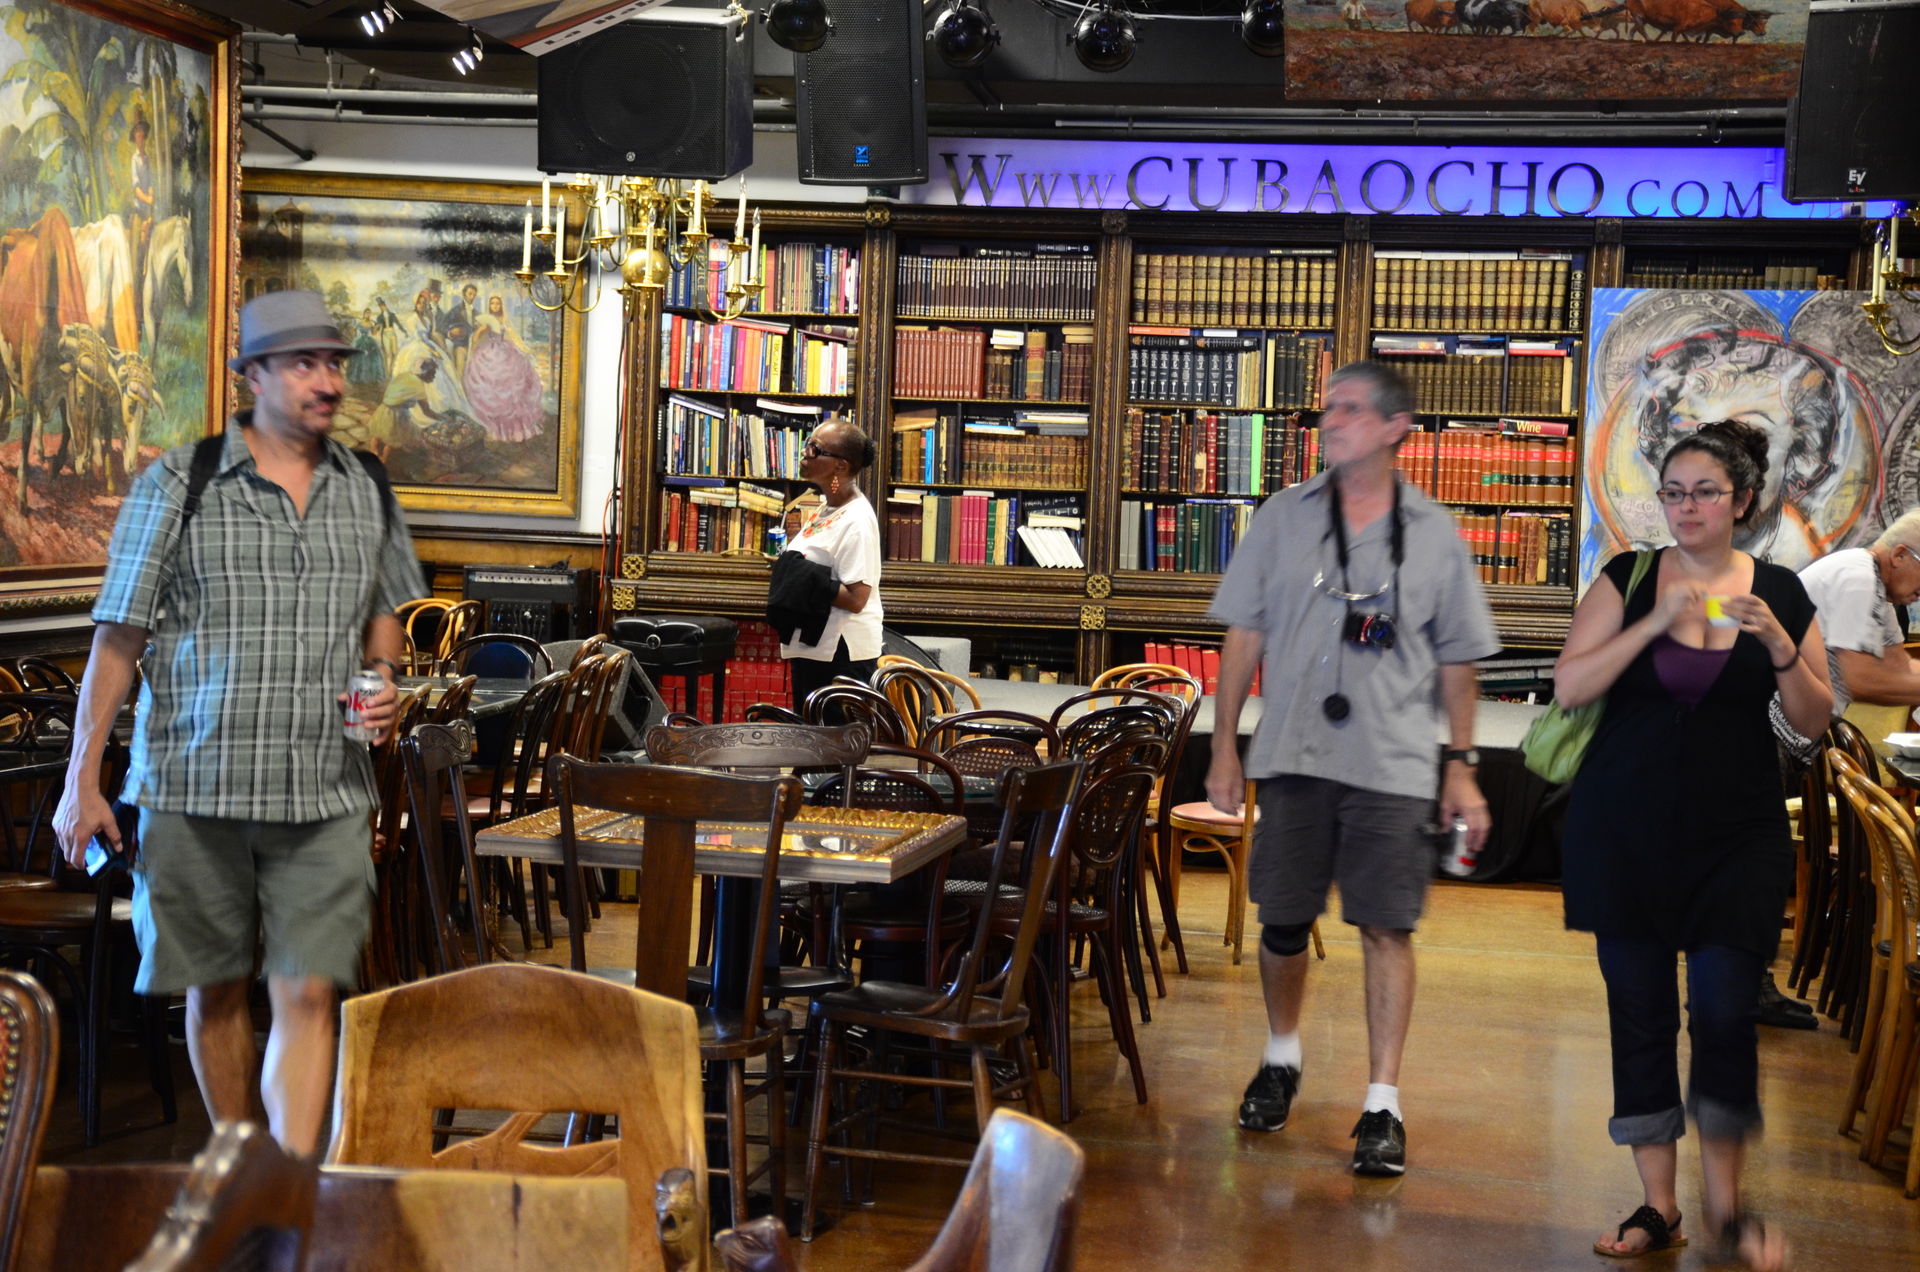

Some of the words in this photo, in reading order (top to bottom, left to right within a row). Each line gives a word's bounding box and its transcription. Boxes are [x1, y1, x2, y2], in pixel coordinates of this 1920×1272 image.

[1848, 169, 1867, 186] EV
[1126, 155, 1605, 217] CUBAOCHO
[1627, 178, 1769, 219] COM
[1516, 420, 1542, 434] Wine
